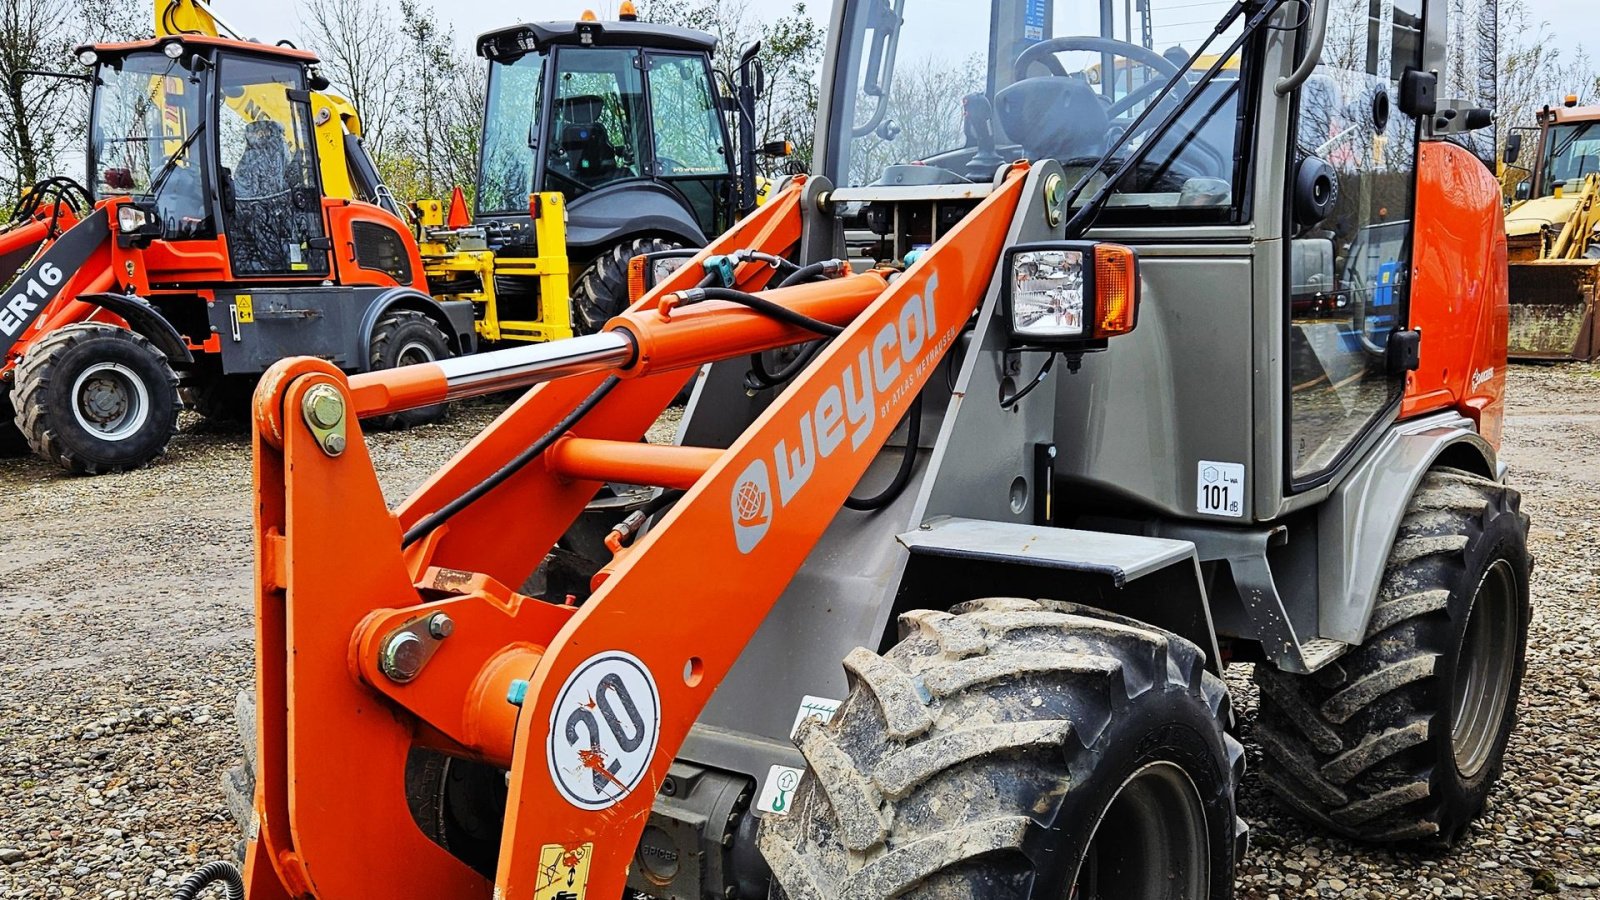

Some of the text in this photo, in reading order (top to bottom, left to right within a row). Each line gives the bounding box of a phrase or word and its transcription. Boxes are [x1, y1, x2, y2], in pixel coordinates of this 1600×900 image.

[0, 262, 63, 337] ER16
[774, 271, 939, 508] weycor
[881, 326, 956, 418] BY ATLAS WEYHAUSEN
[1203, 484, 1239, 512] 101 dB
[565, 672, 646, 795] 20
[643, 844, 679, 861] SPICER
